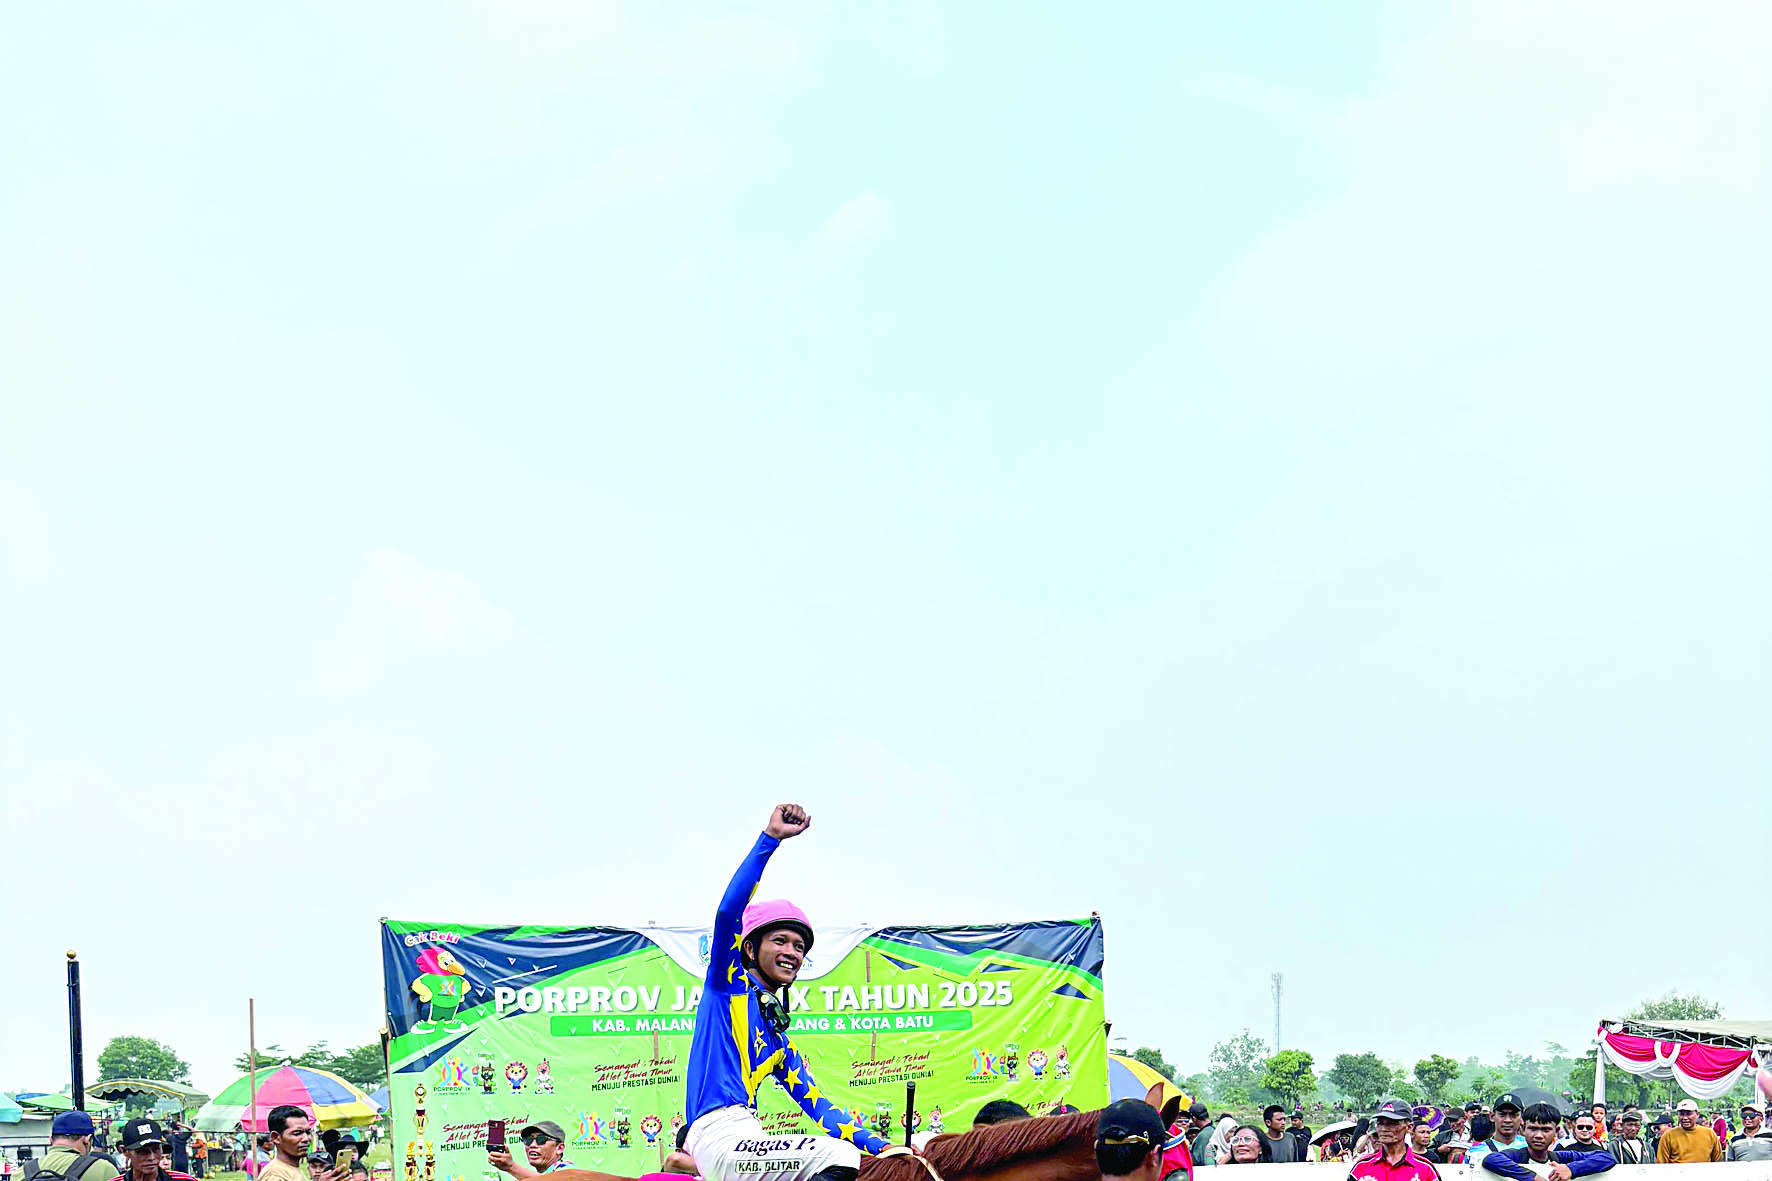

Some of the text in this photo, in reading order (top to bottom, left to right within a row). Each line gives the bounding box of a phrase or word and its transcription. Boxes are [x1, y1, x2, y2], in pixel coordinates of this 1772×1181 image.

[494, 985, 662, 1012] PORPROV
[820, 984, 929, 1011] TAHUN
[938, 980, 1013, 1008] 2025
[592, 1017, 696, 1032] KAB. MALAN
[834, 1018, 846, 1030] &
[851, 1016, 889, 1030] KOTA
[895, 1015, 934, 1029] BATU
[624, 1069, 648, 1080] Jawa
[849, 1070, 934, 1087] MENUJU PRESTASI DUNIA!
[591, 1075, 680, 1091] MENUJU PRESTASI DUNIA!
[440, 1141, 470, 1151] MENUJU
[733, 1138, 793, 1157] Bagas
[738, 1160, 800, 1172] KAB. BLITAR
